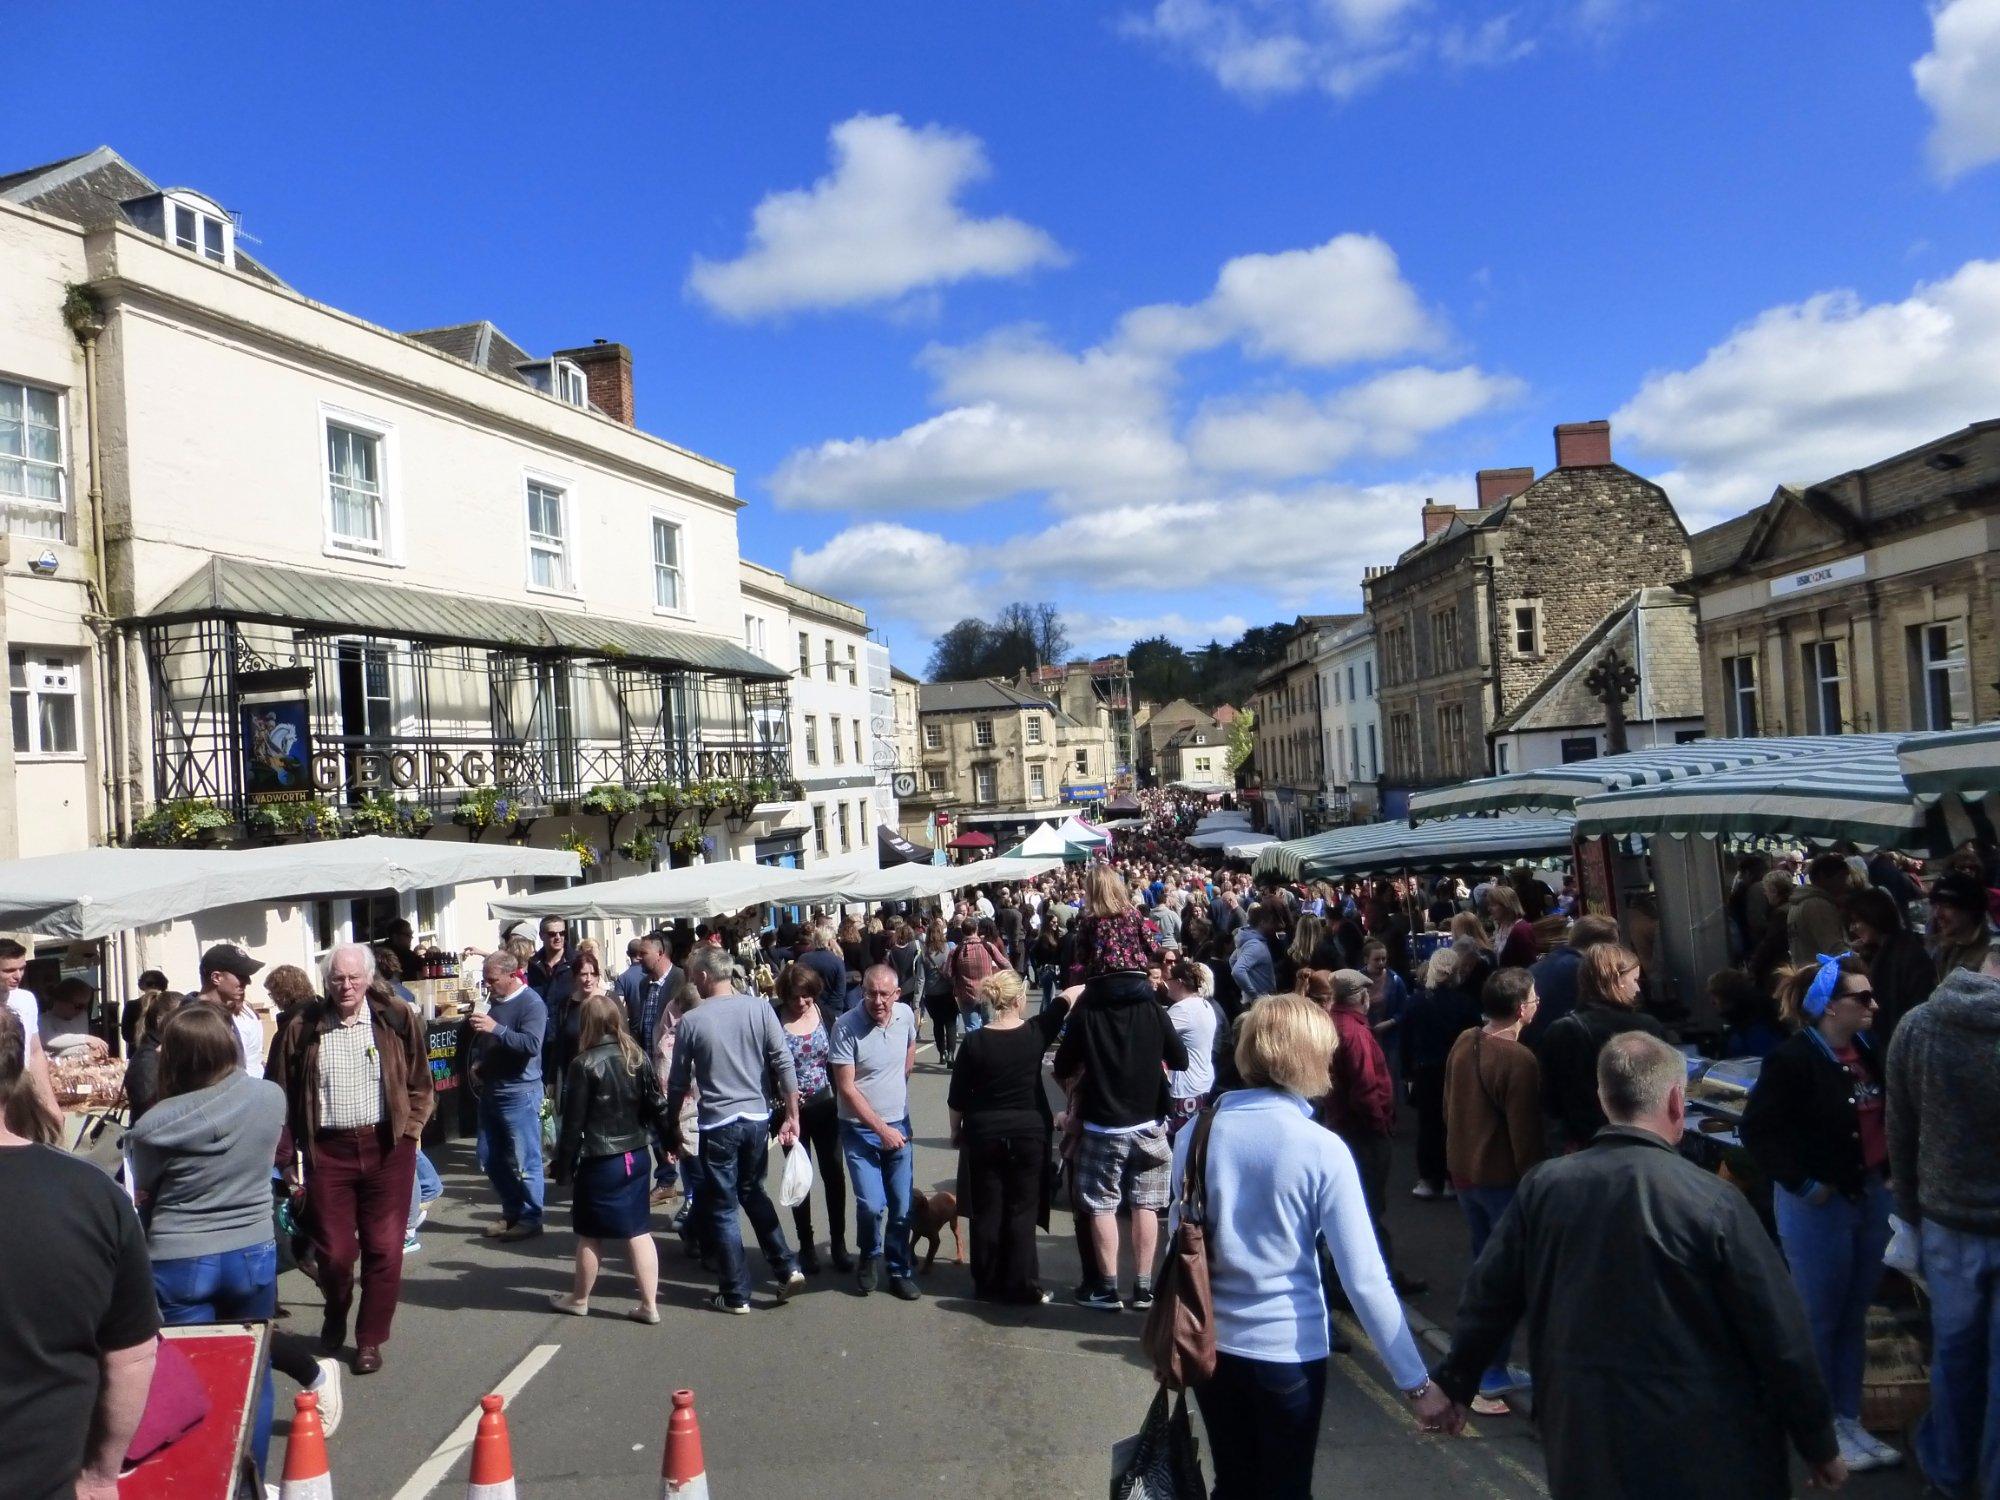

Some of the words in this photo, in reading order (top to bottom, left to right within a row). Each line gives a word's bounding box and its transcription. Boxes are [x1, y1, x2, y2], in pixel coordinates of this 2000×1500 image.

[312, 750, 517, 789] GEORGE
[700, 752, 778, 777] HOTEL
[252, 792, 306, 803] WADWORTH
[430, 1029, 457, 1049] BEERS
